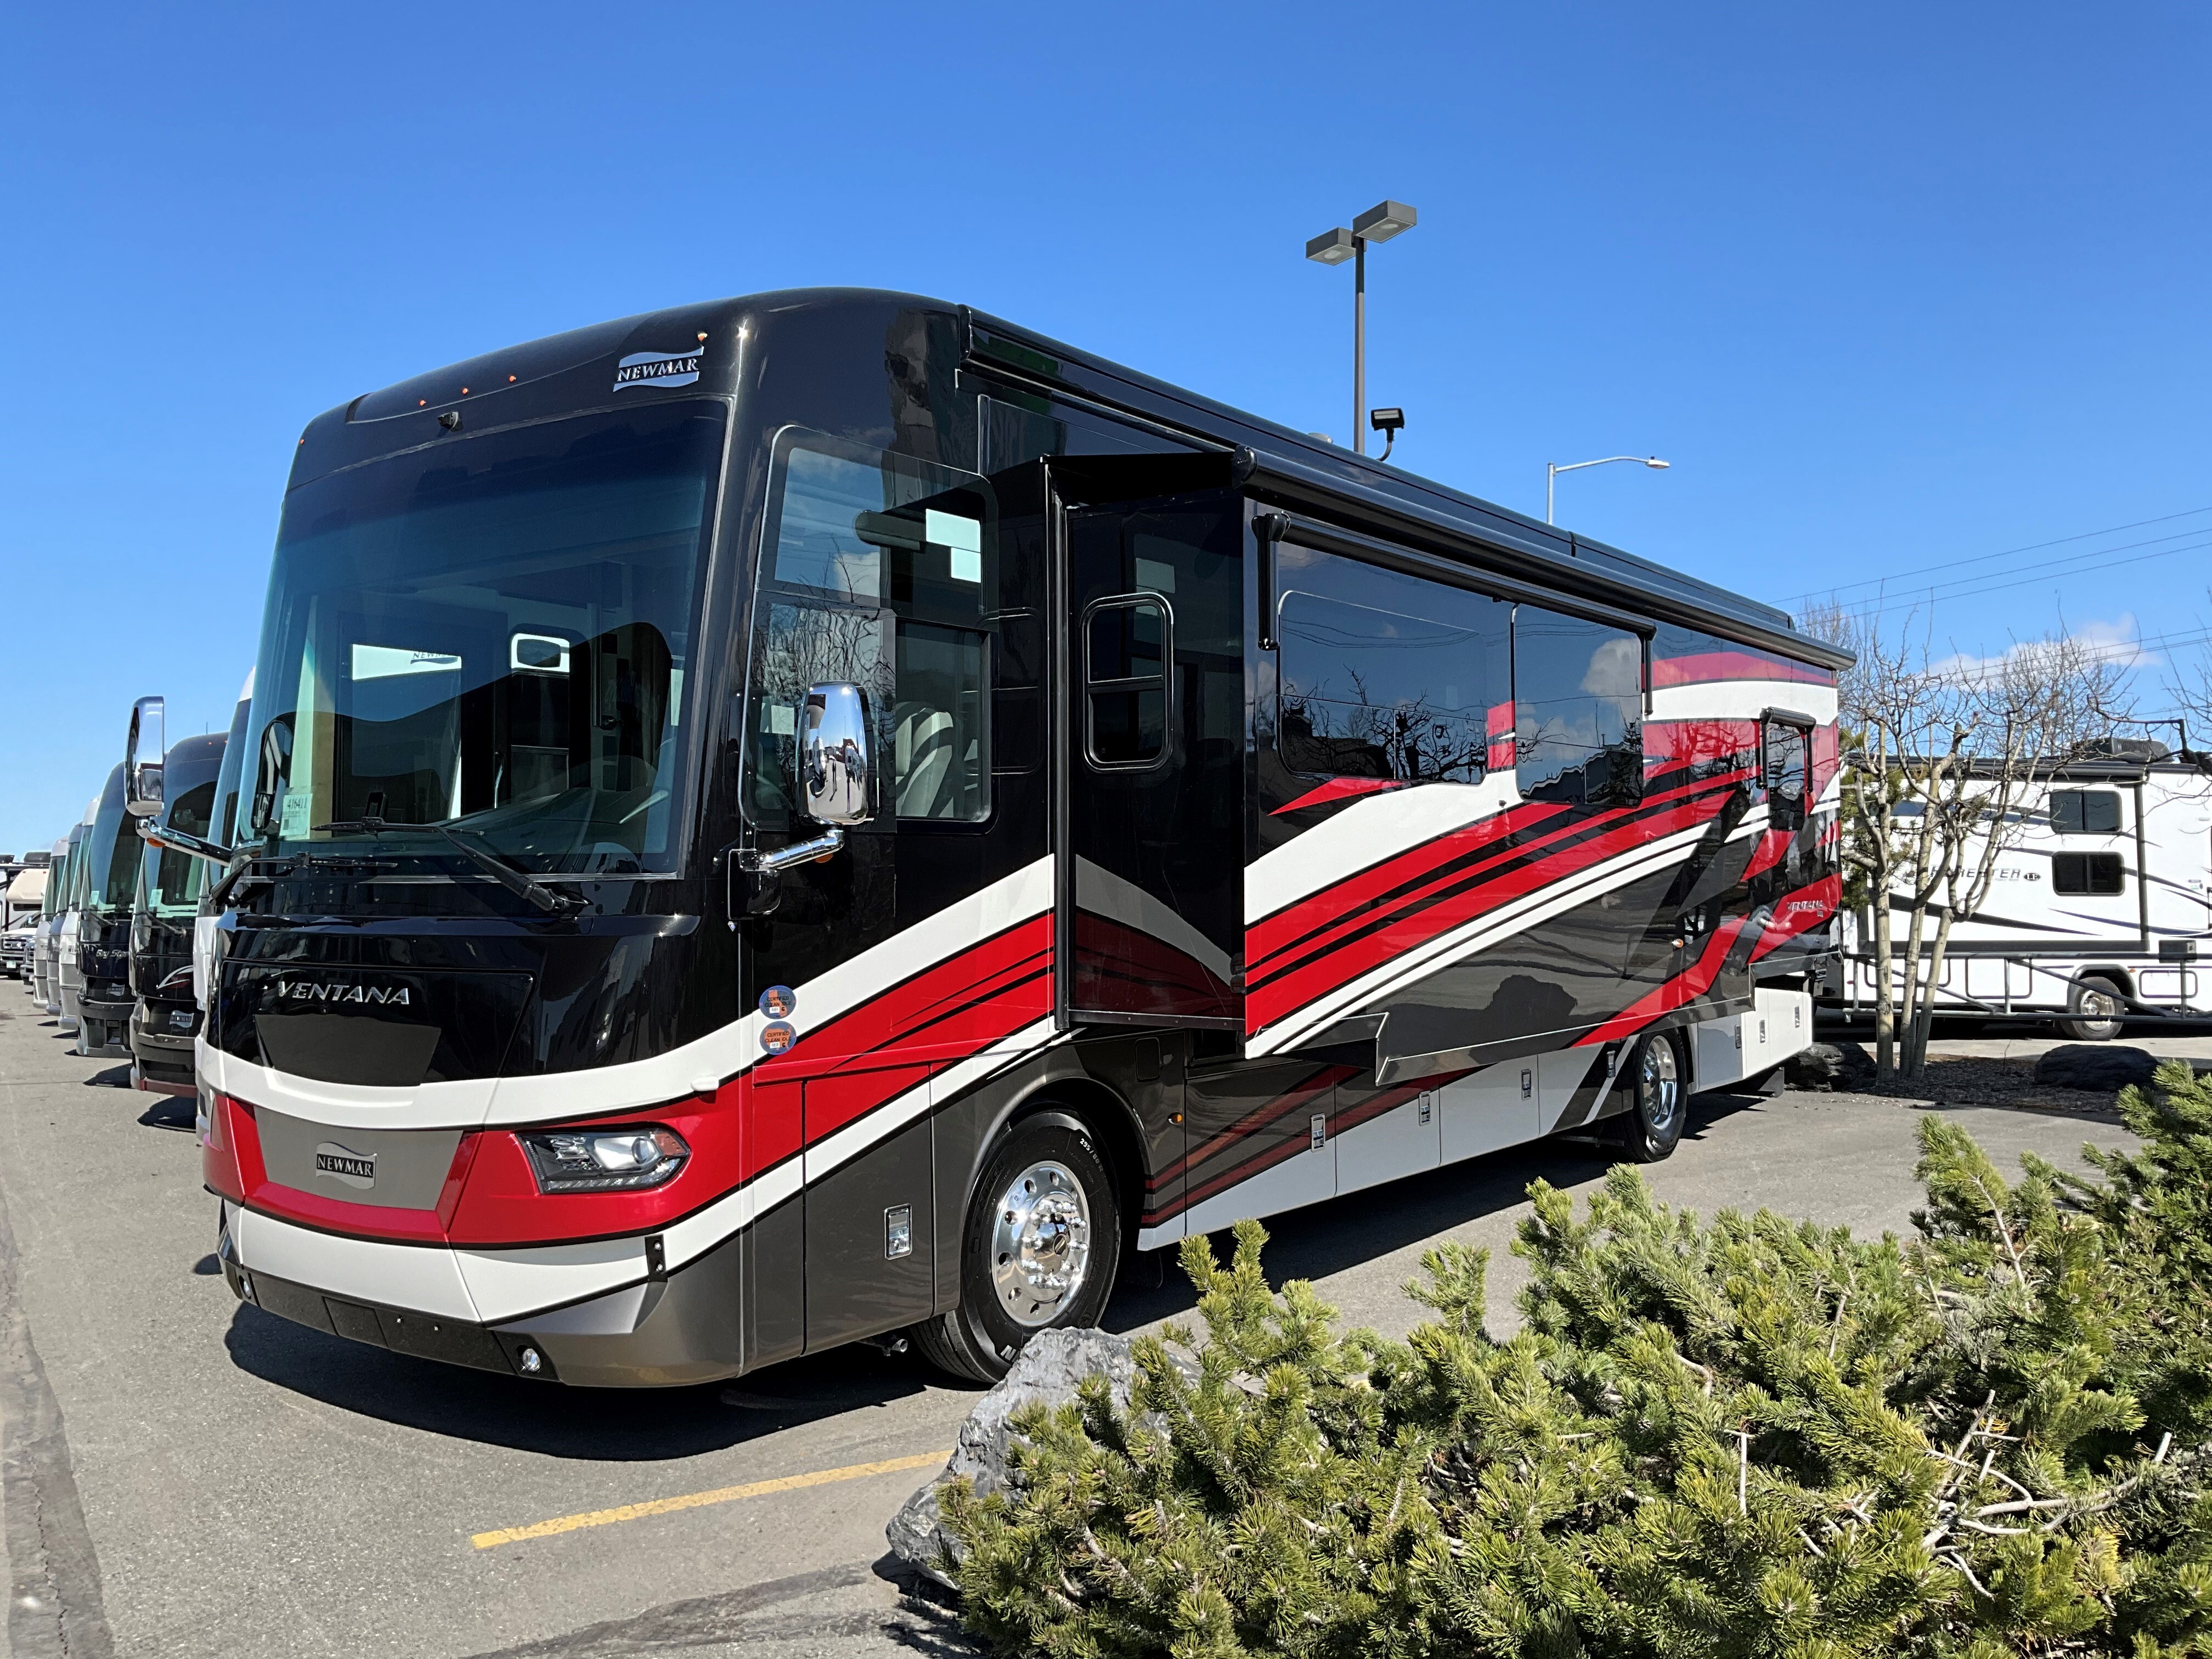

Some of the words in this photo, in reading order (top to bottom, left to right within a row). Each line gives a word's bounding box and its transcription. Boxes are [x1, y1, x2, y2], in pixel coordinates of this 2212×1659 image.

[617, 358, 698, 382] NEWMAR
[278, 981, 410, 1005] VENTANA
[1079, 1138, 1100, 1164] 295/80
[318, 1156, 372, 1176] NEWMAR
